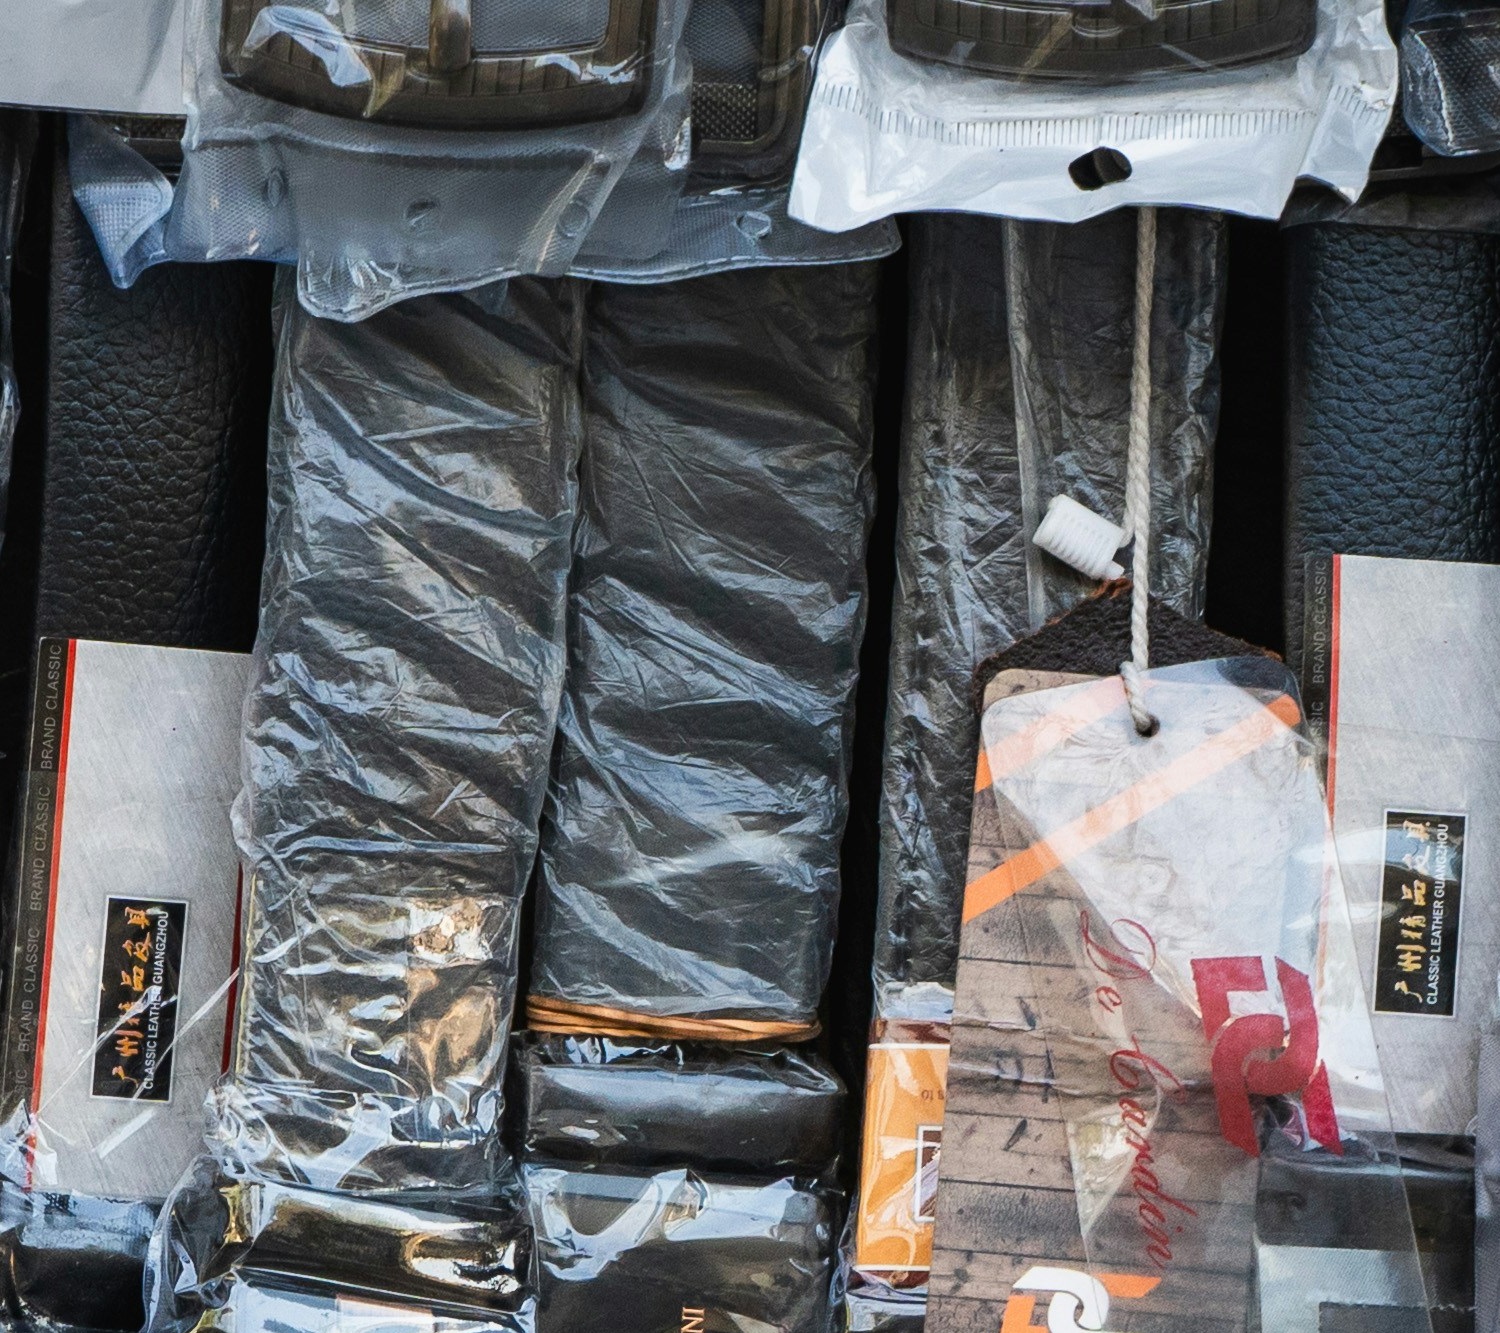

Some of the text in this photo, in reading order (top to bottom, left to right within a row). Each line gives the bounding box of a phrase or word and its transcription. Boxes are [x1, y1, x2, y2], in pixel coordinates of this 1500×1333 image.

[1312, 560, 1327, 625] CLASSIC
[44, 644, 62, 710] CLASSIC
[1312, 631, 1326, 684] BRAND
[40, 716, 57, 770] BRAND
[34, 786, 51, 851] CLASSIC
[28, 858, 46, 911] BRAND
[1427, 823, 1448, 1005] CLASSIC LEATHER GUANGZHOU
[23, 927, 40, 993] CLASSIC
[18, 999, 34, 1052] BRAND
[144, 1040, 157, 1090] CLASSIC
